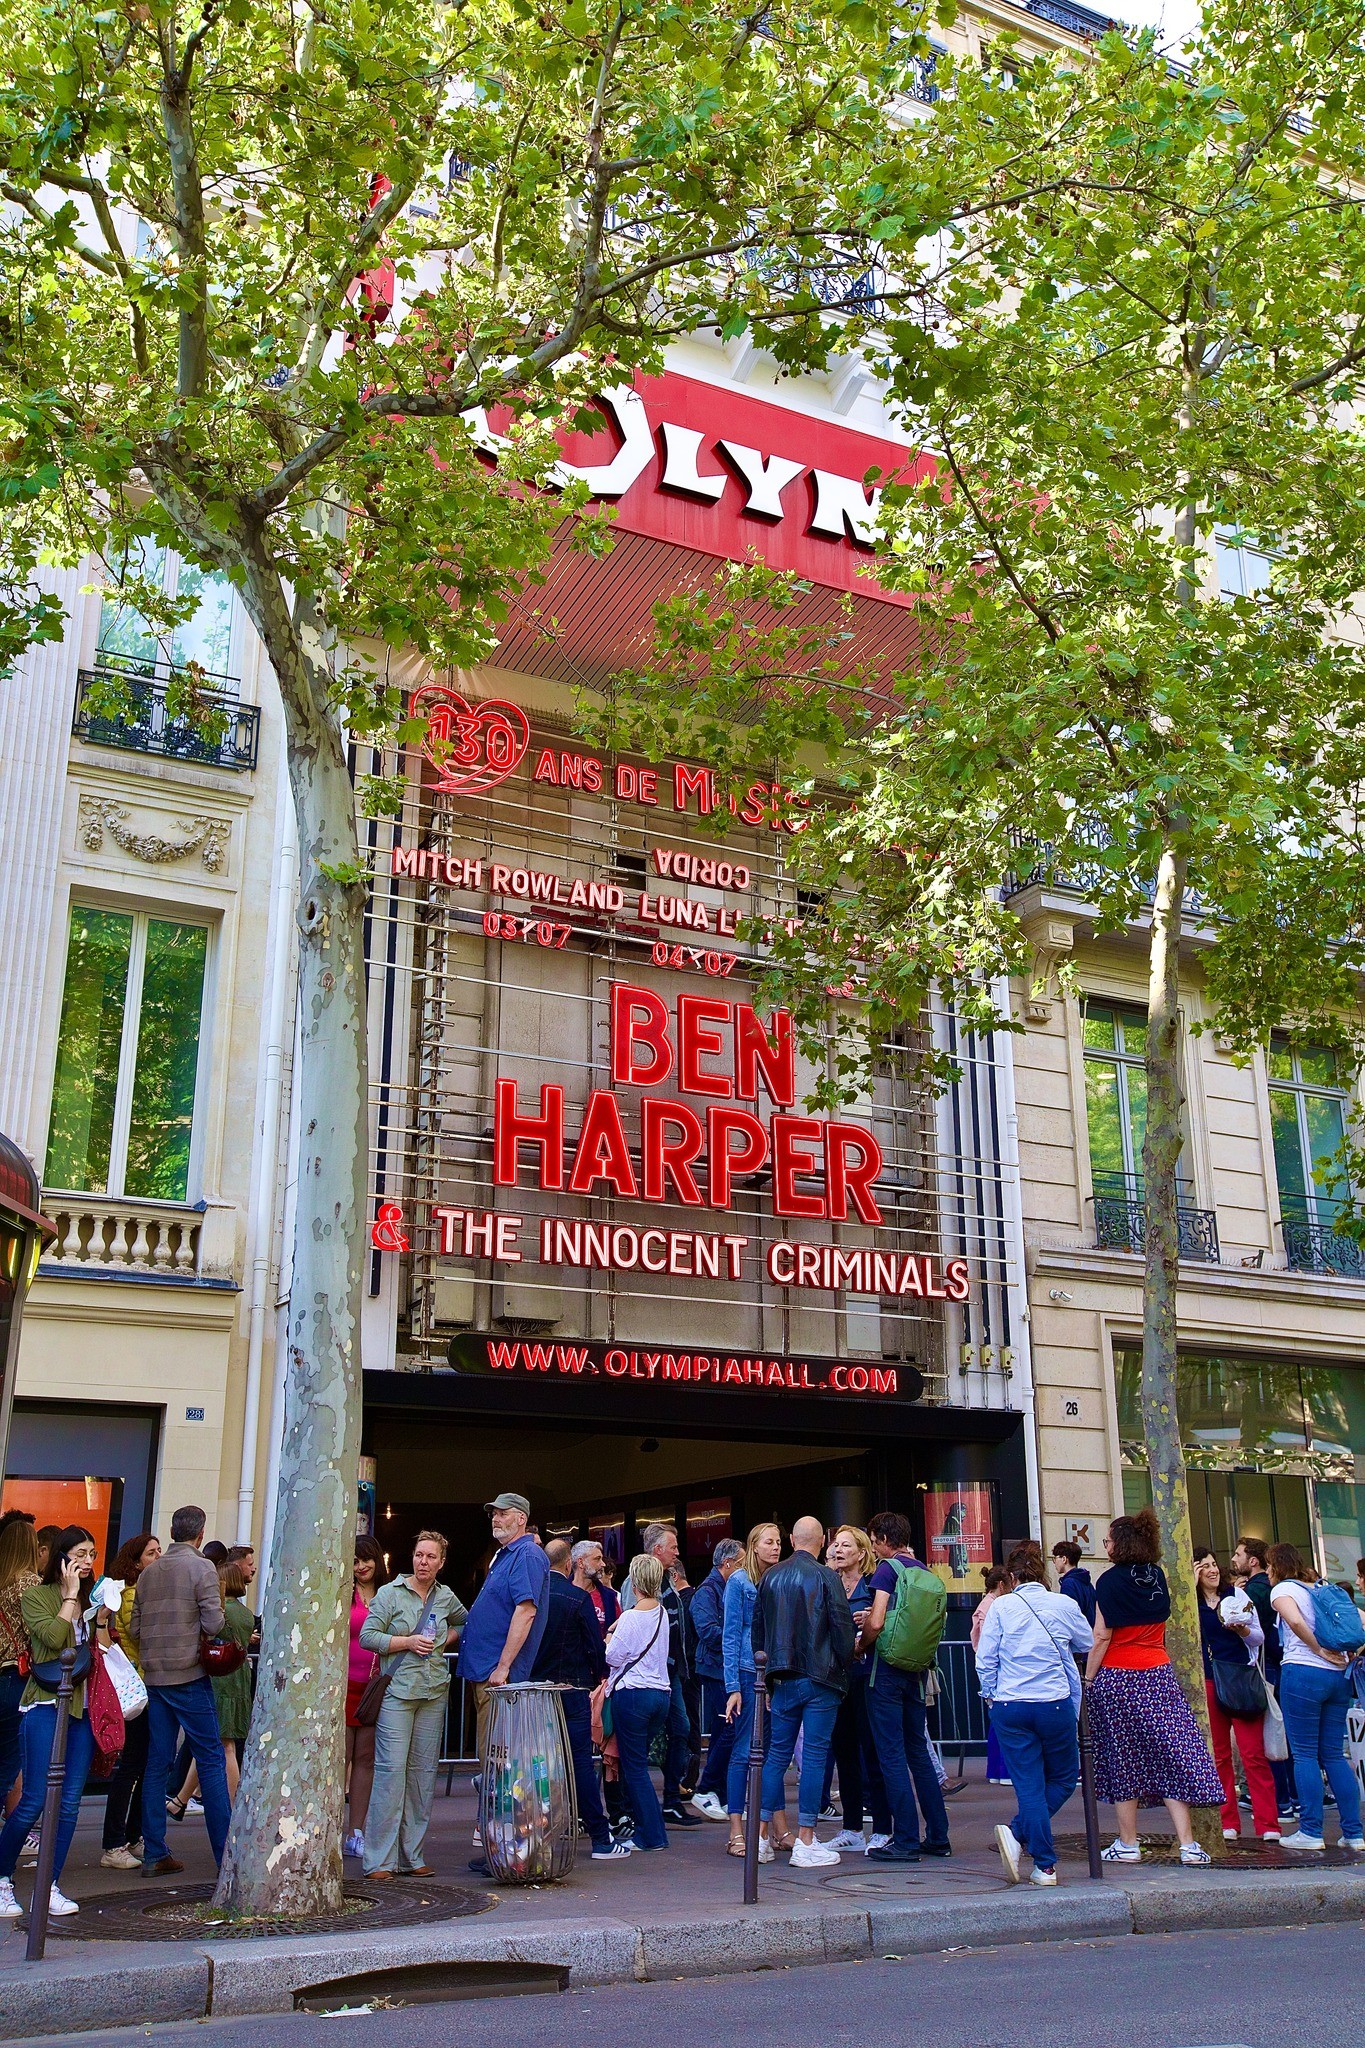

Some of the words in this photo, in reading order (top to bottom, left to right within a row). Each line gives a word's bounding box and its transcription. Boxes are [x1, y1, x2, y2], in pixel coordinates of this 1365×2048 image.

[428, 711, 517, 770] 130
[532, 748, 603, 793] ANS
[615, 763, 659, 806] DE
[392, 846, 482, 889] MITCH
[490, 863, 624, 914] ROWLAND
[638, 892, 710, 931] LUNA
[482, 910, 572, 949] 03/07
[610, 983, 795, 1107] BEN
[493, 1078, 884, 1225] HARPER
[372, 1203, 410, 1252] &
[433, 1207, 522, 1262] THE
[540, 1219, 748, 1280] INNOCENT
[767, 1242, 969, 1300] CRIMINALS
[1066, 1401, 1078, 1415] 26
